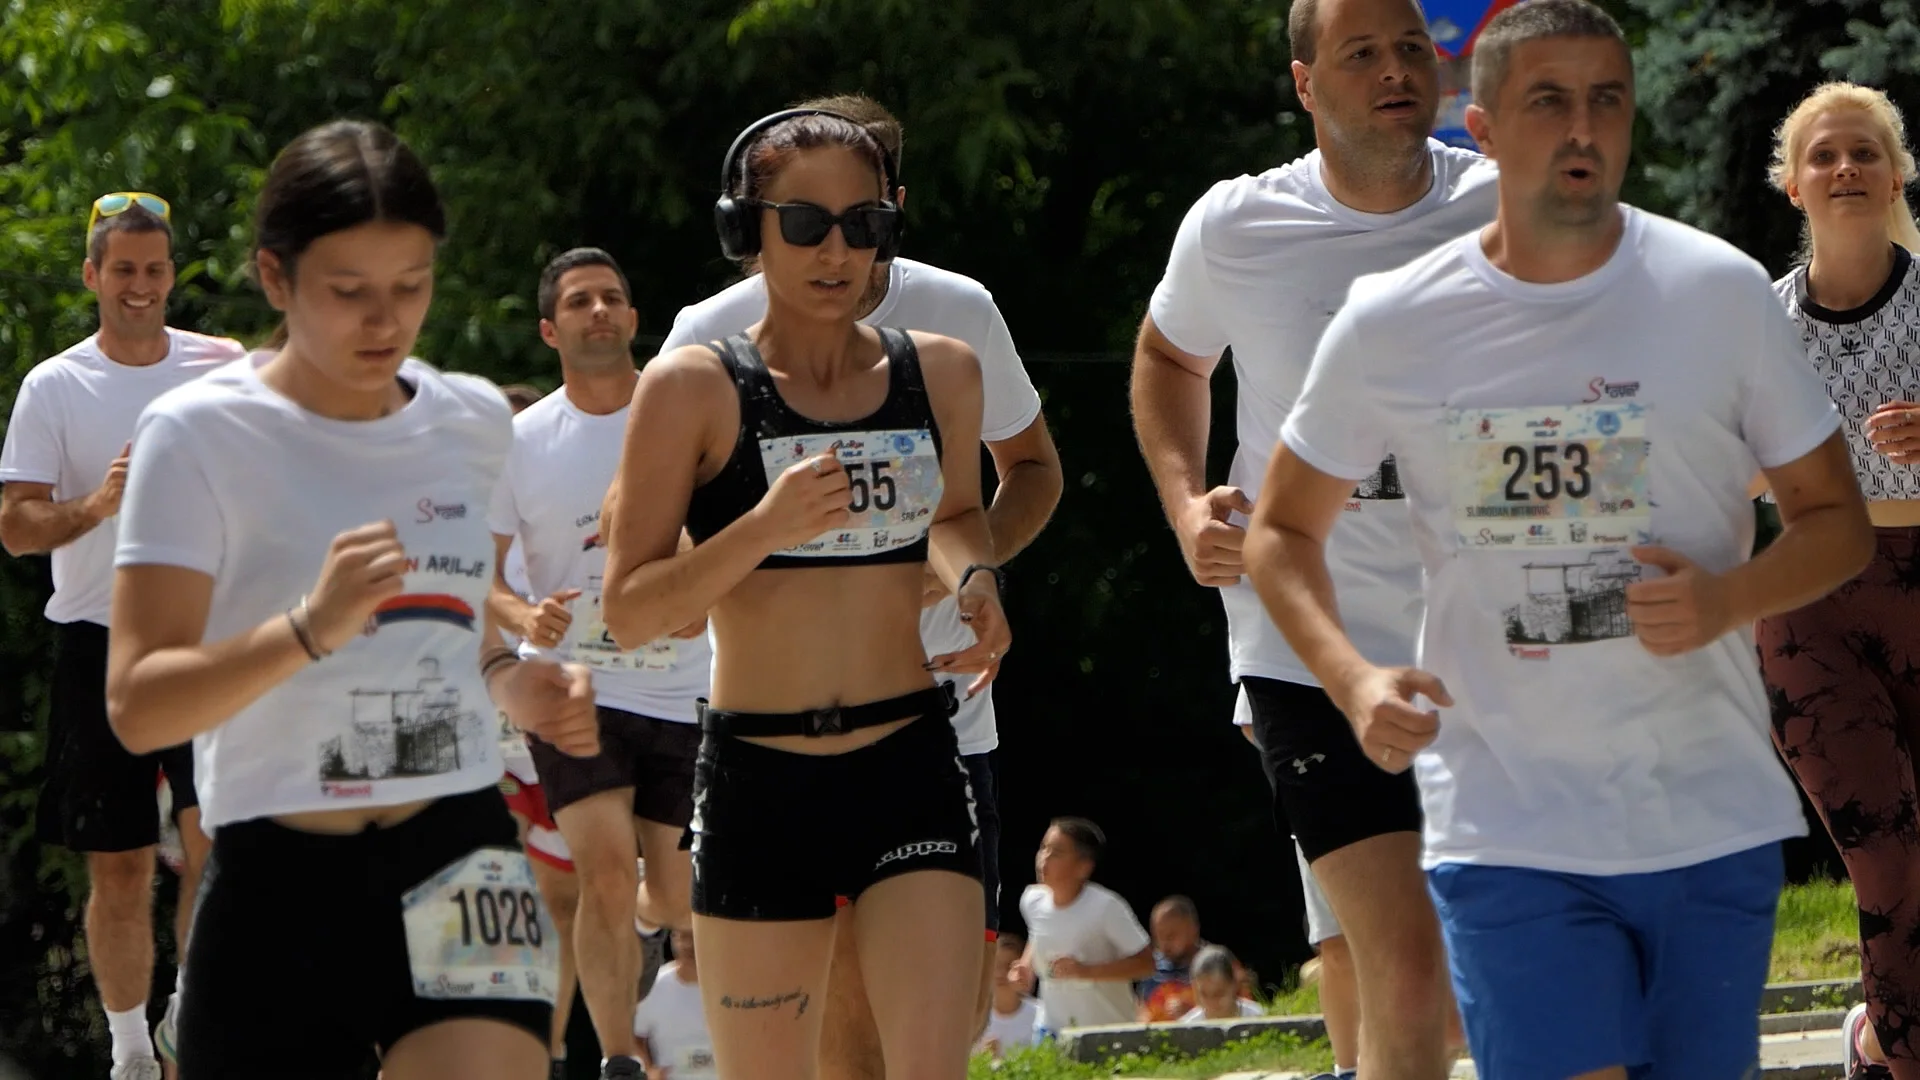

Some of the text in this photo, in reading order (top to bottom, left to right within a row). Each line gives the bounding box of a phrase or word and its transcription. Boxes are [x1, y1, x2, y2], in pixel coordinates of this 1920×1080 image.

[843, 460, 897, 514] 55
[1503, 442, 1592, 502] 253
[575, 510, 600, 528] COLO
[900, 511, 916, 522] SRB
[405, 553, 486, 578] N ARILJE
[449, 887, 543, 948] 1028
